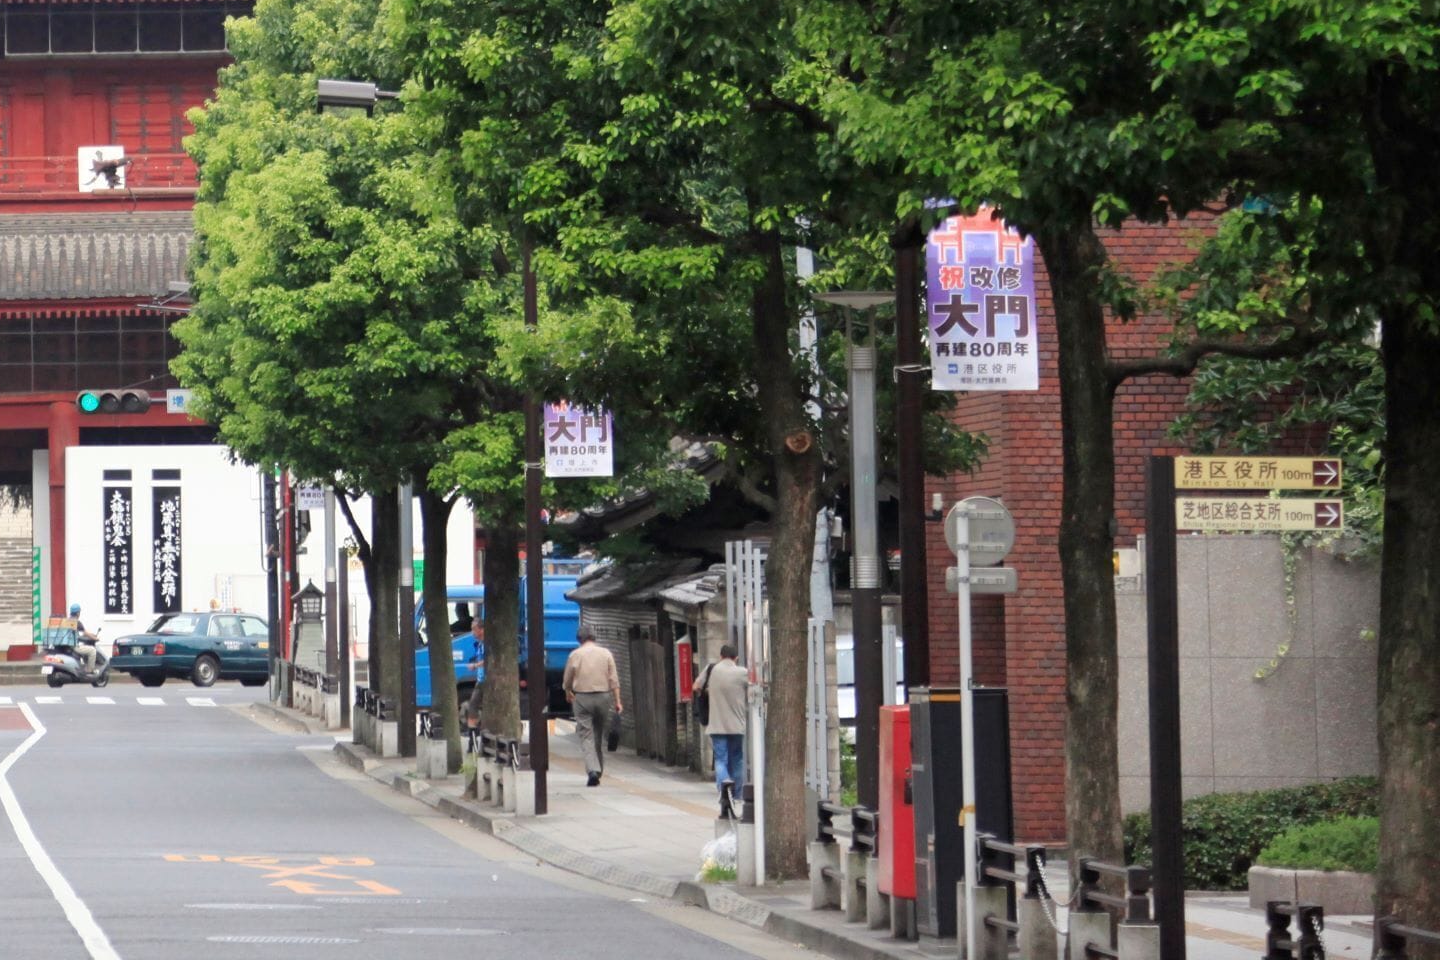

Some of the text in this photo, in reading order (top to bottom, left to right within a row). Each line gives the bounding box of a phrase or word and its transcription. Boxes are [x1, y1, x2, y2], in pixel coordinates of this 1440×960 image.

[940, 266, 1021, 290] 祝改修
[934, 294, 1029, 338] 大門
[936, 341, 1029, 357] 再建80周年
[963, 363, 1017, 375] 港区役所
[548, 415, 608, 443] 大門
[549, 445, 609, 456] 再建80周年
[1184, 461, 1311, 480] 港区役所 100m
[1226, 480, 1246, 488] City
[1183, 500, 1313, 521] 芝地区総合支所 100m
